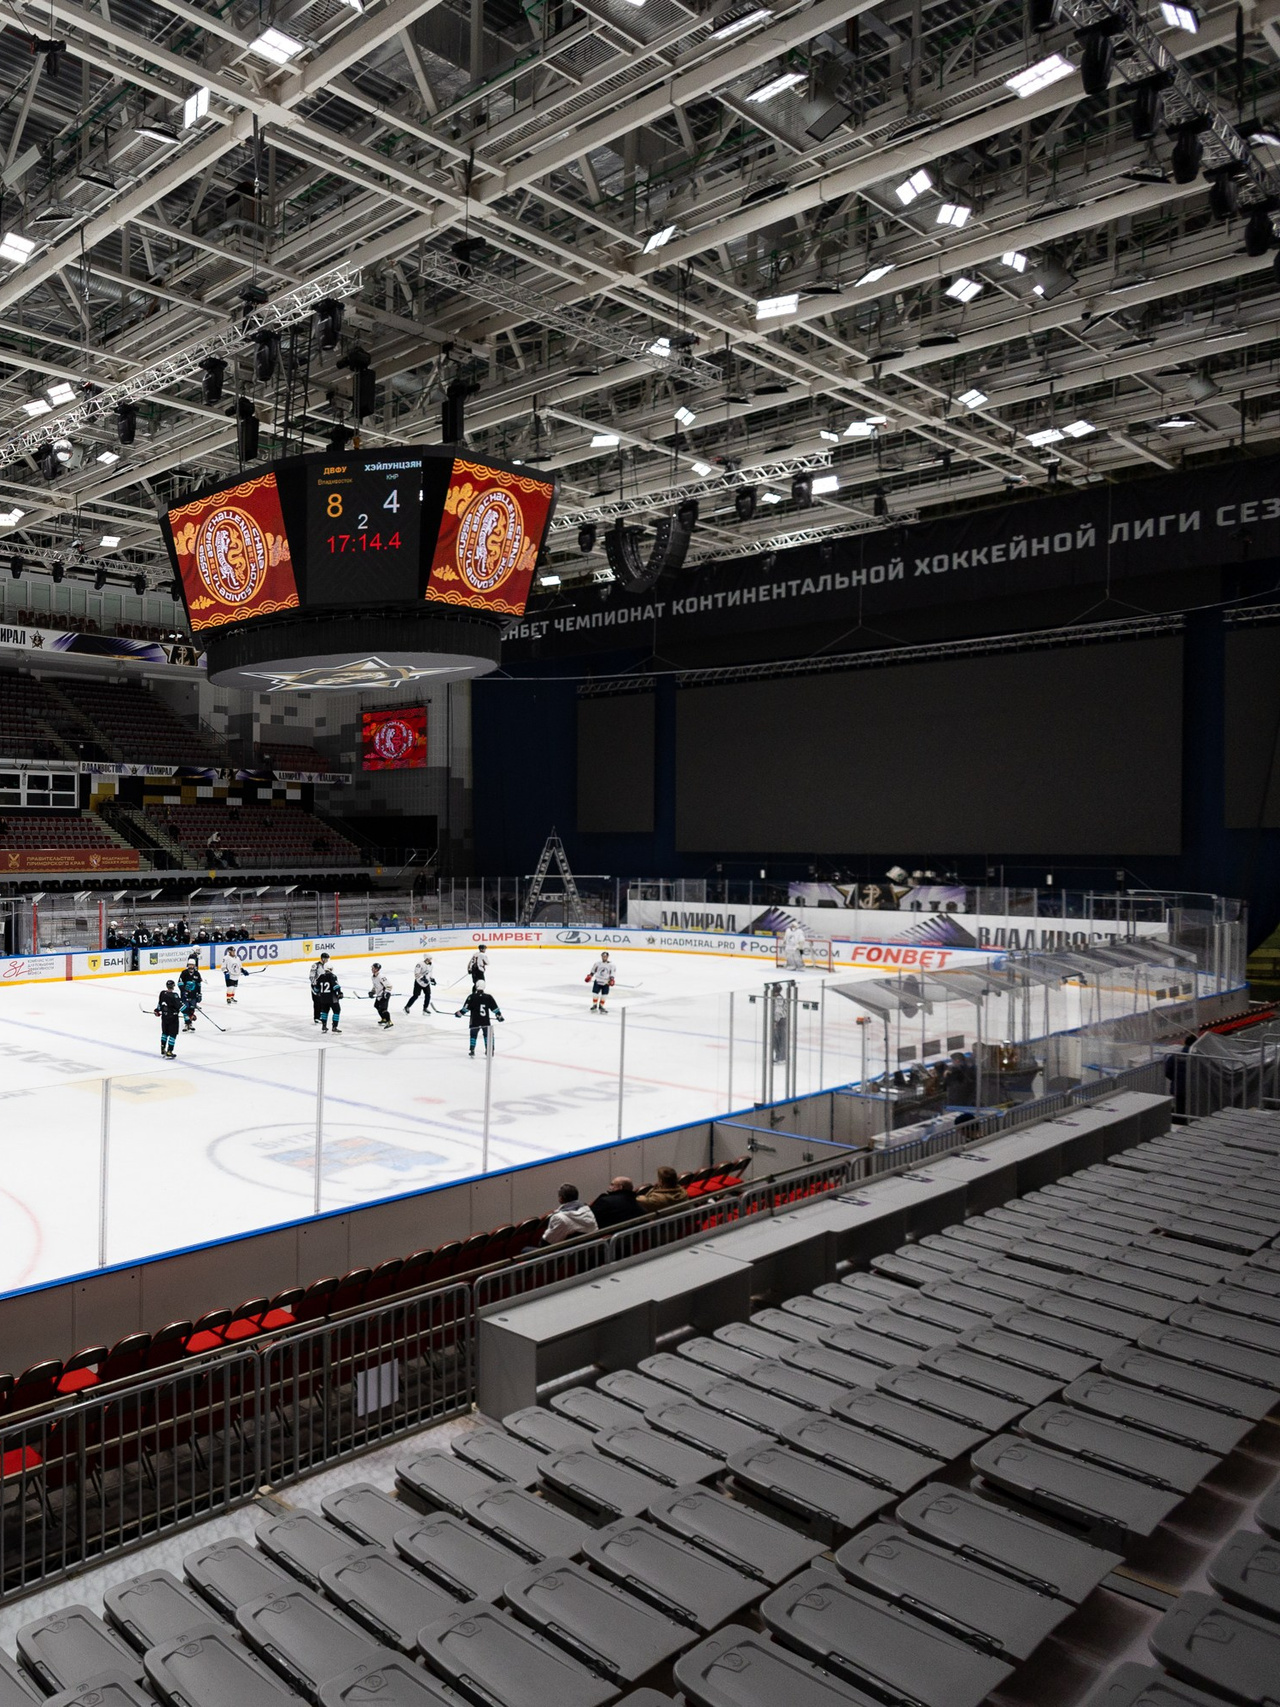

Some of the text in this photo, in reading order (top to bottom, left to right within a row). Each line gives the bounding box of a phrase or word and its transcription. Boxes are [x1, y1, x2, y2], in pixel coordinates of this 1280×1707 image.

[323, 466, 347, 475] ДВФУ
[364, 460, 422, 472] ХЭЙЛУНЦЗЯН
[326, 493, 343, 518] 8
[382, 489, 400, 513] 4
[357, 513, 368, 529] 2
[327, 531, 402, 553] 17:14.4
[500, 620, 550, 641] НБЕТ
[554, 602, 666, 633] ЧЕМПИОНАТ
[672, 556, 904, 617] КОНТИНЕНТАЛЬНОЙ
[914, 522, 1096, 577] ХОККЕЙНОЙ
[1107, 509, 1201, 544] ЛИГИ
[138, 934, 148, 943] 13
[472, 932, 543, 942] OLIMPBET
[594, 934, 631, 944] LADA
[315, 942, 336, 951] БАНК
[660, 938, 735, 950] HCADMIRAL.PRO
[750, 941, 840, 958] Ростеком
[103, 957, 129, 967] БАНК
[851, 945, 953, 968] FONBET
[319, 981, 330, 993] 12
[479, 1004, 486, 1017] 5
